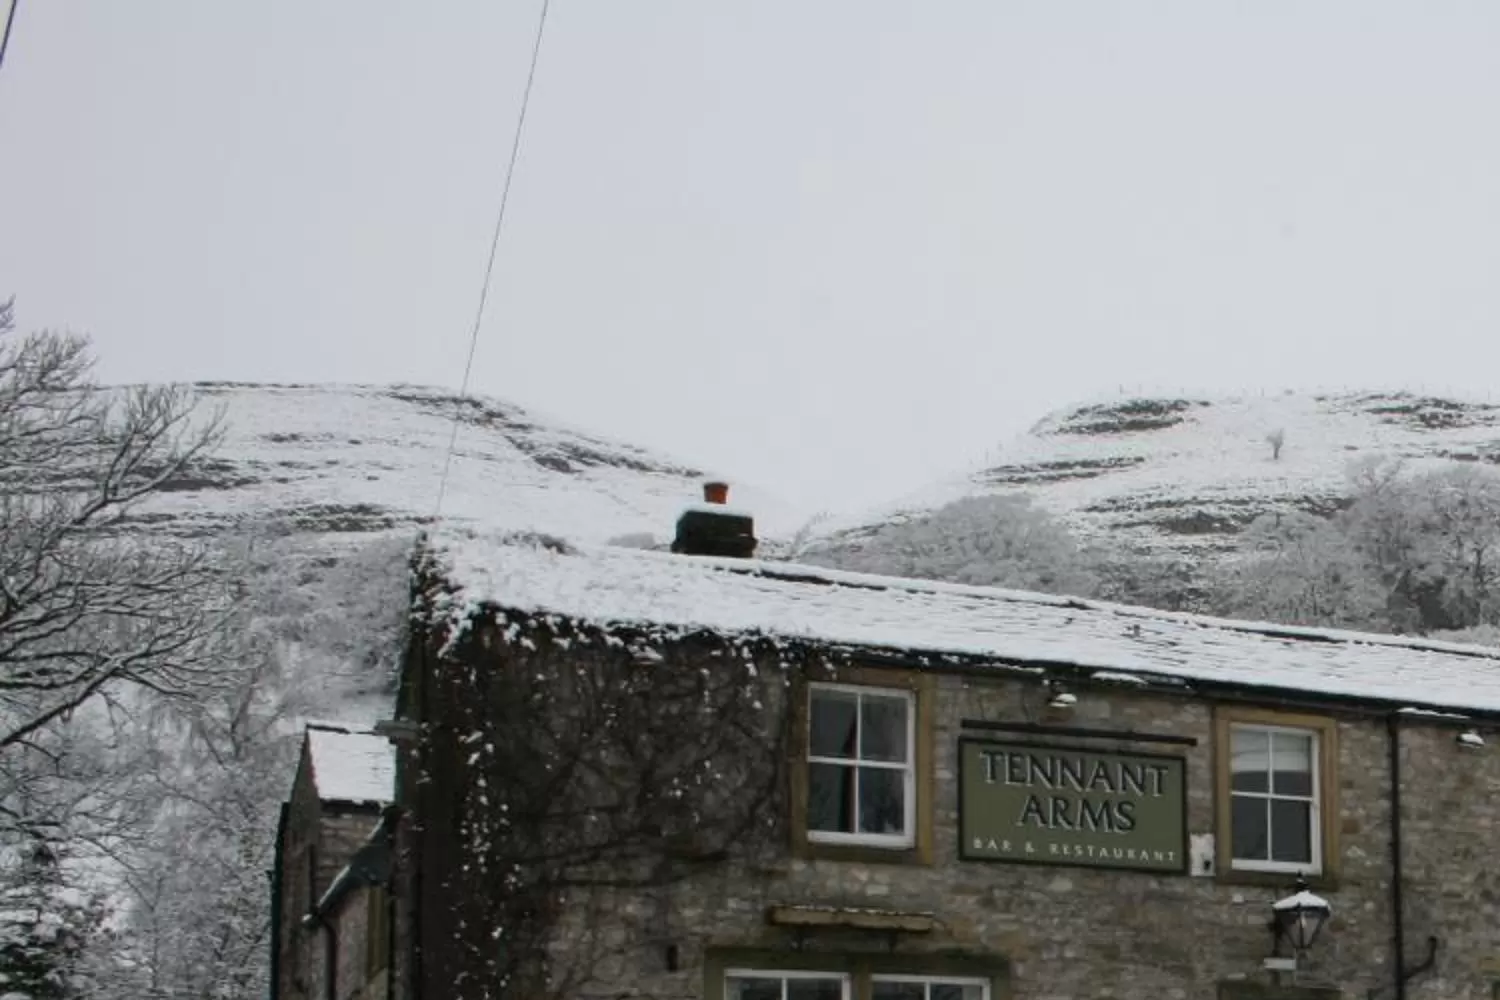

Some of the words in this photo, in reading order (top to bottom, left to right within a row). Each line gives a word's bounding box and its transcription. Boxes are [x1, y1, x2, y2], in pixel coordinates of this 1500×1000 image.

[980, 750, 1169, 797] TENNANT
[1016, 794, 1137, 834] ARMS
[973, 836, 1012, 852] BAR
[1024, 840, 1035, 853] &
[1049, 842, 1176, 863] RESTAURANT
